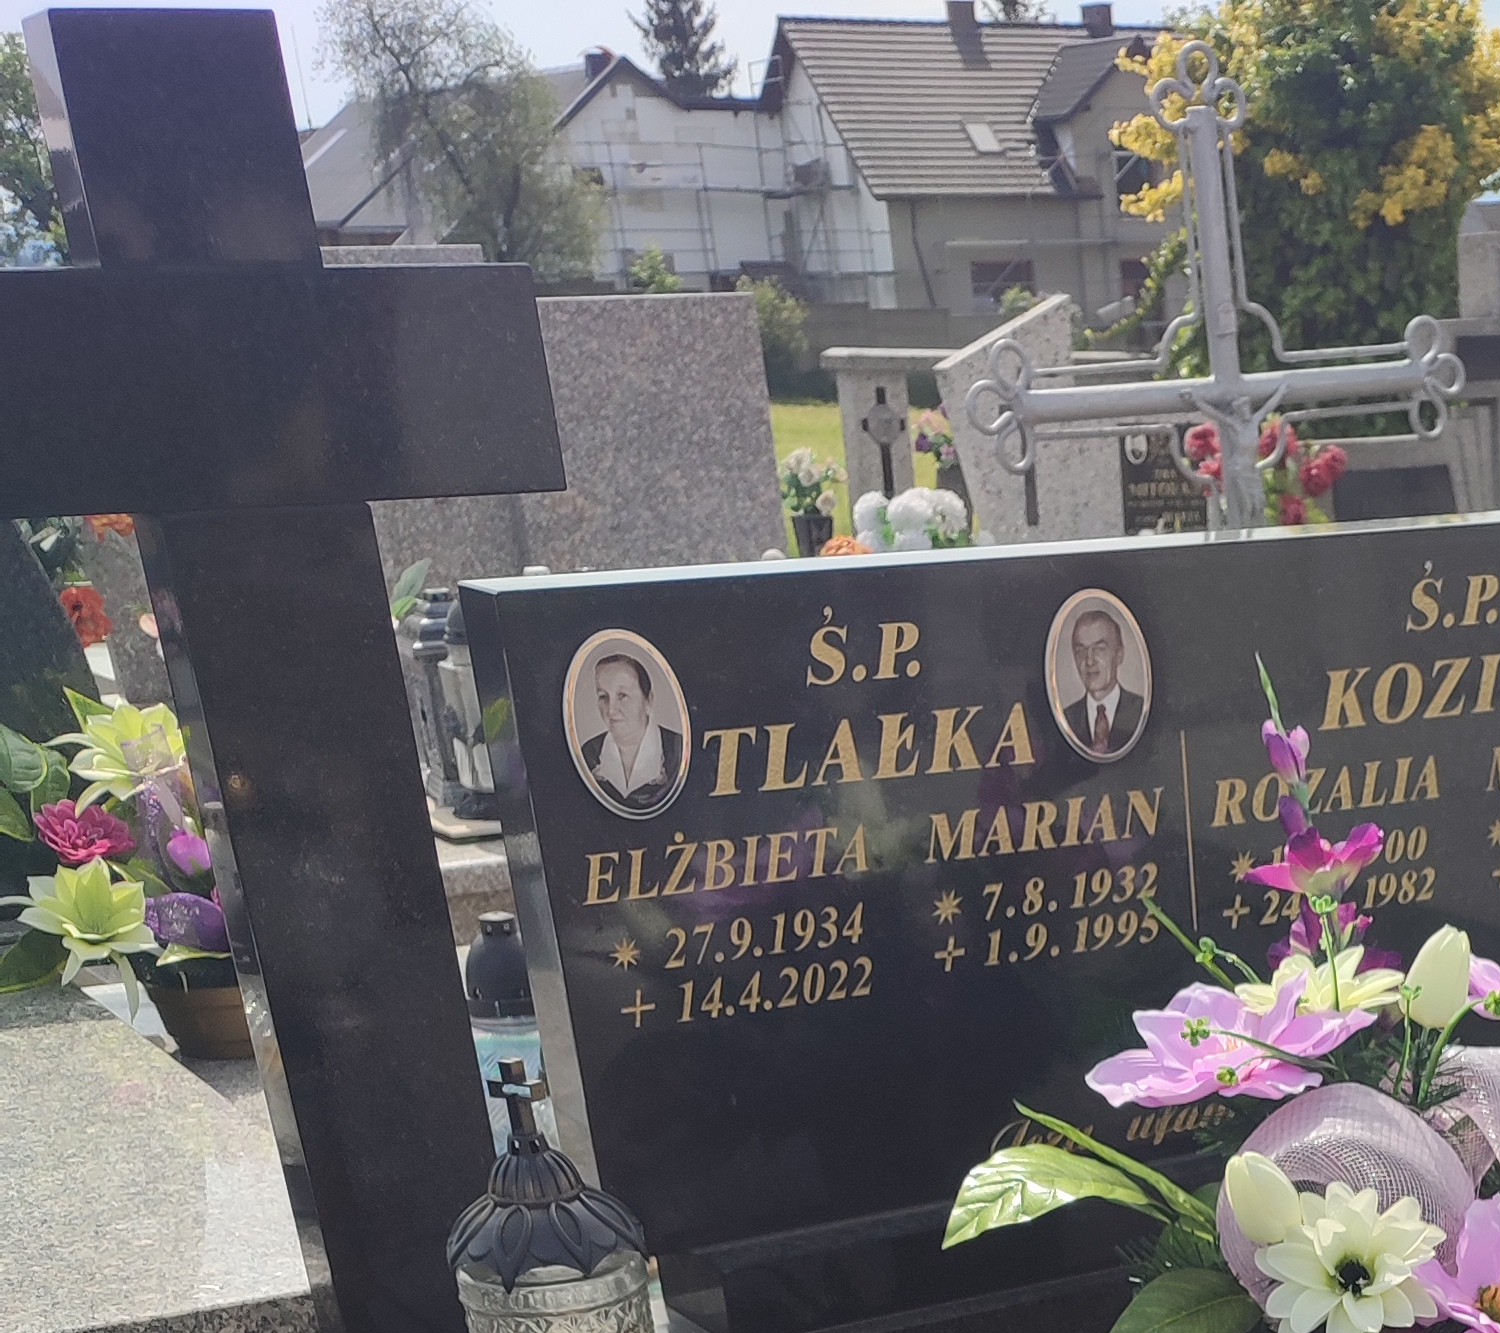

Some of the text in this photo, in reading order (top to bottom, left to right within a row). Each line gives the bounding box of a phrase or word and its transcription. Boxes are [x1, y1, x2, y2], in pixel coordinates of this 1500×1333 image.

[1405, 560, 1500, 632] Ś.P.
[806, 605, 922, 688] Ś.P.
[702, 701, 1036, 797] TLAŁKA
[582, 786, 1164, 906] ELŻBIETA MARIAN
[664, 901, 865, 969] 27.9.1934
[676, 956, 874, 1023] 14.4.2022
